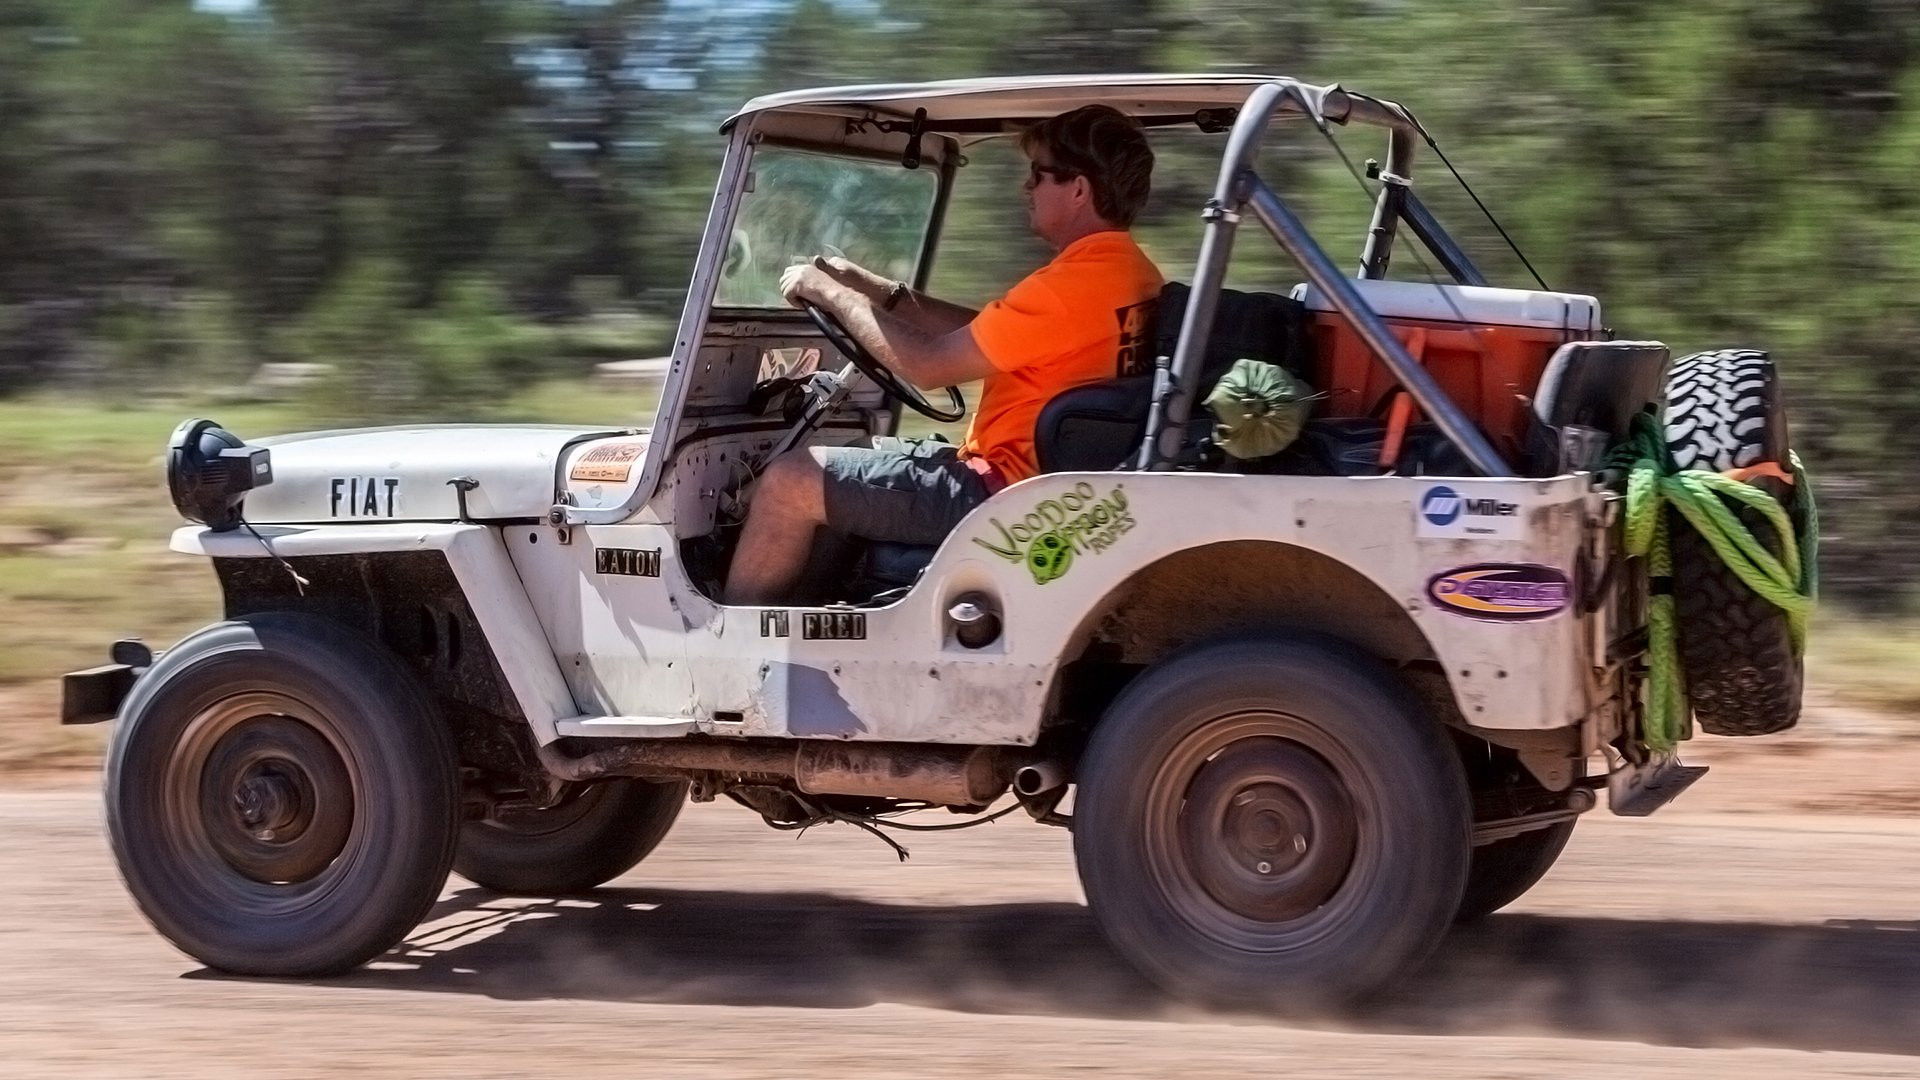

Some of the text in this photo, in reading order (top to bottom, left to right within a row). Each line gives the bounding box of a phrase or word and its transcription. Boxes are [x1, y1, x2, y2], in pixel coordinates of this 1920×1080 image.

[331, 477, 399, 517] FIAT
[1464, 498, 1519, 516] Miller
[597, 549, 660, 577] EATON
[761, 610, 866, 639] I'M FRED
